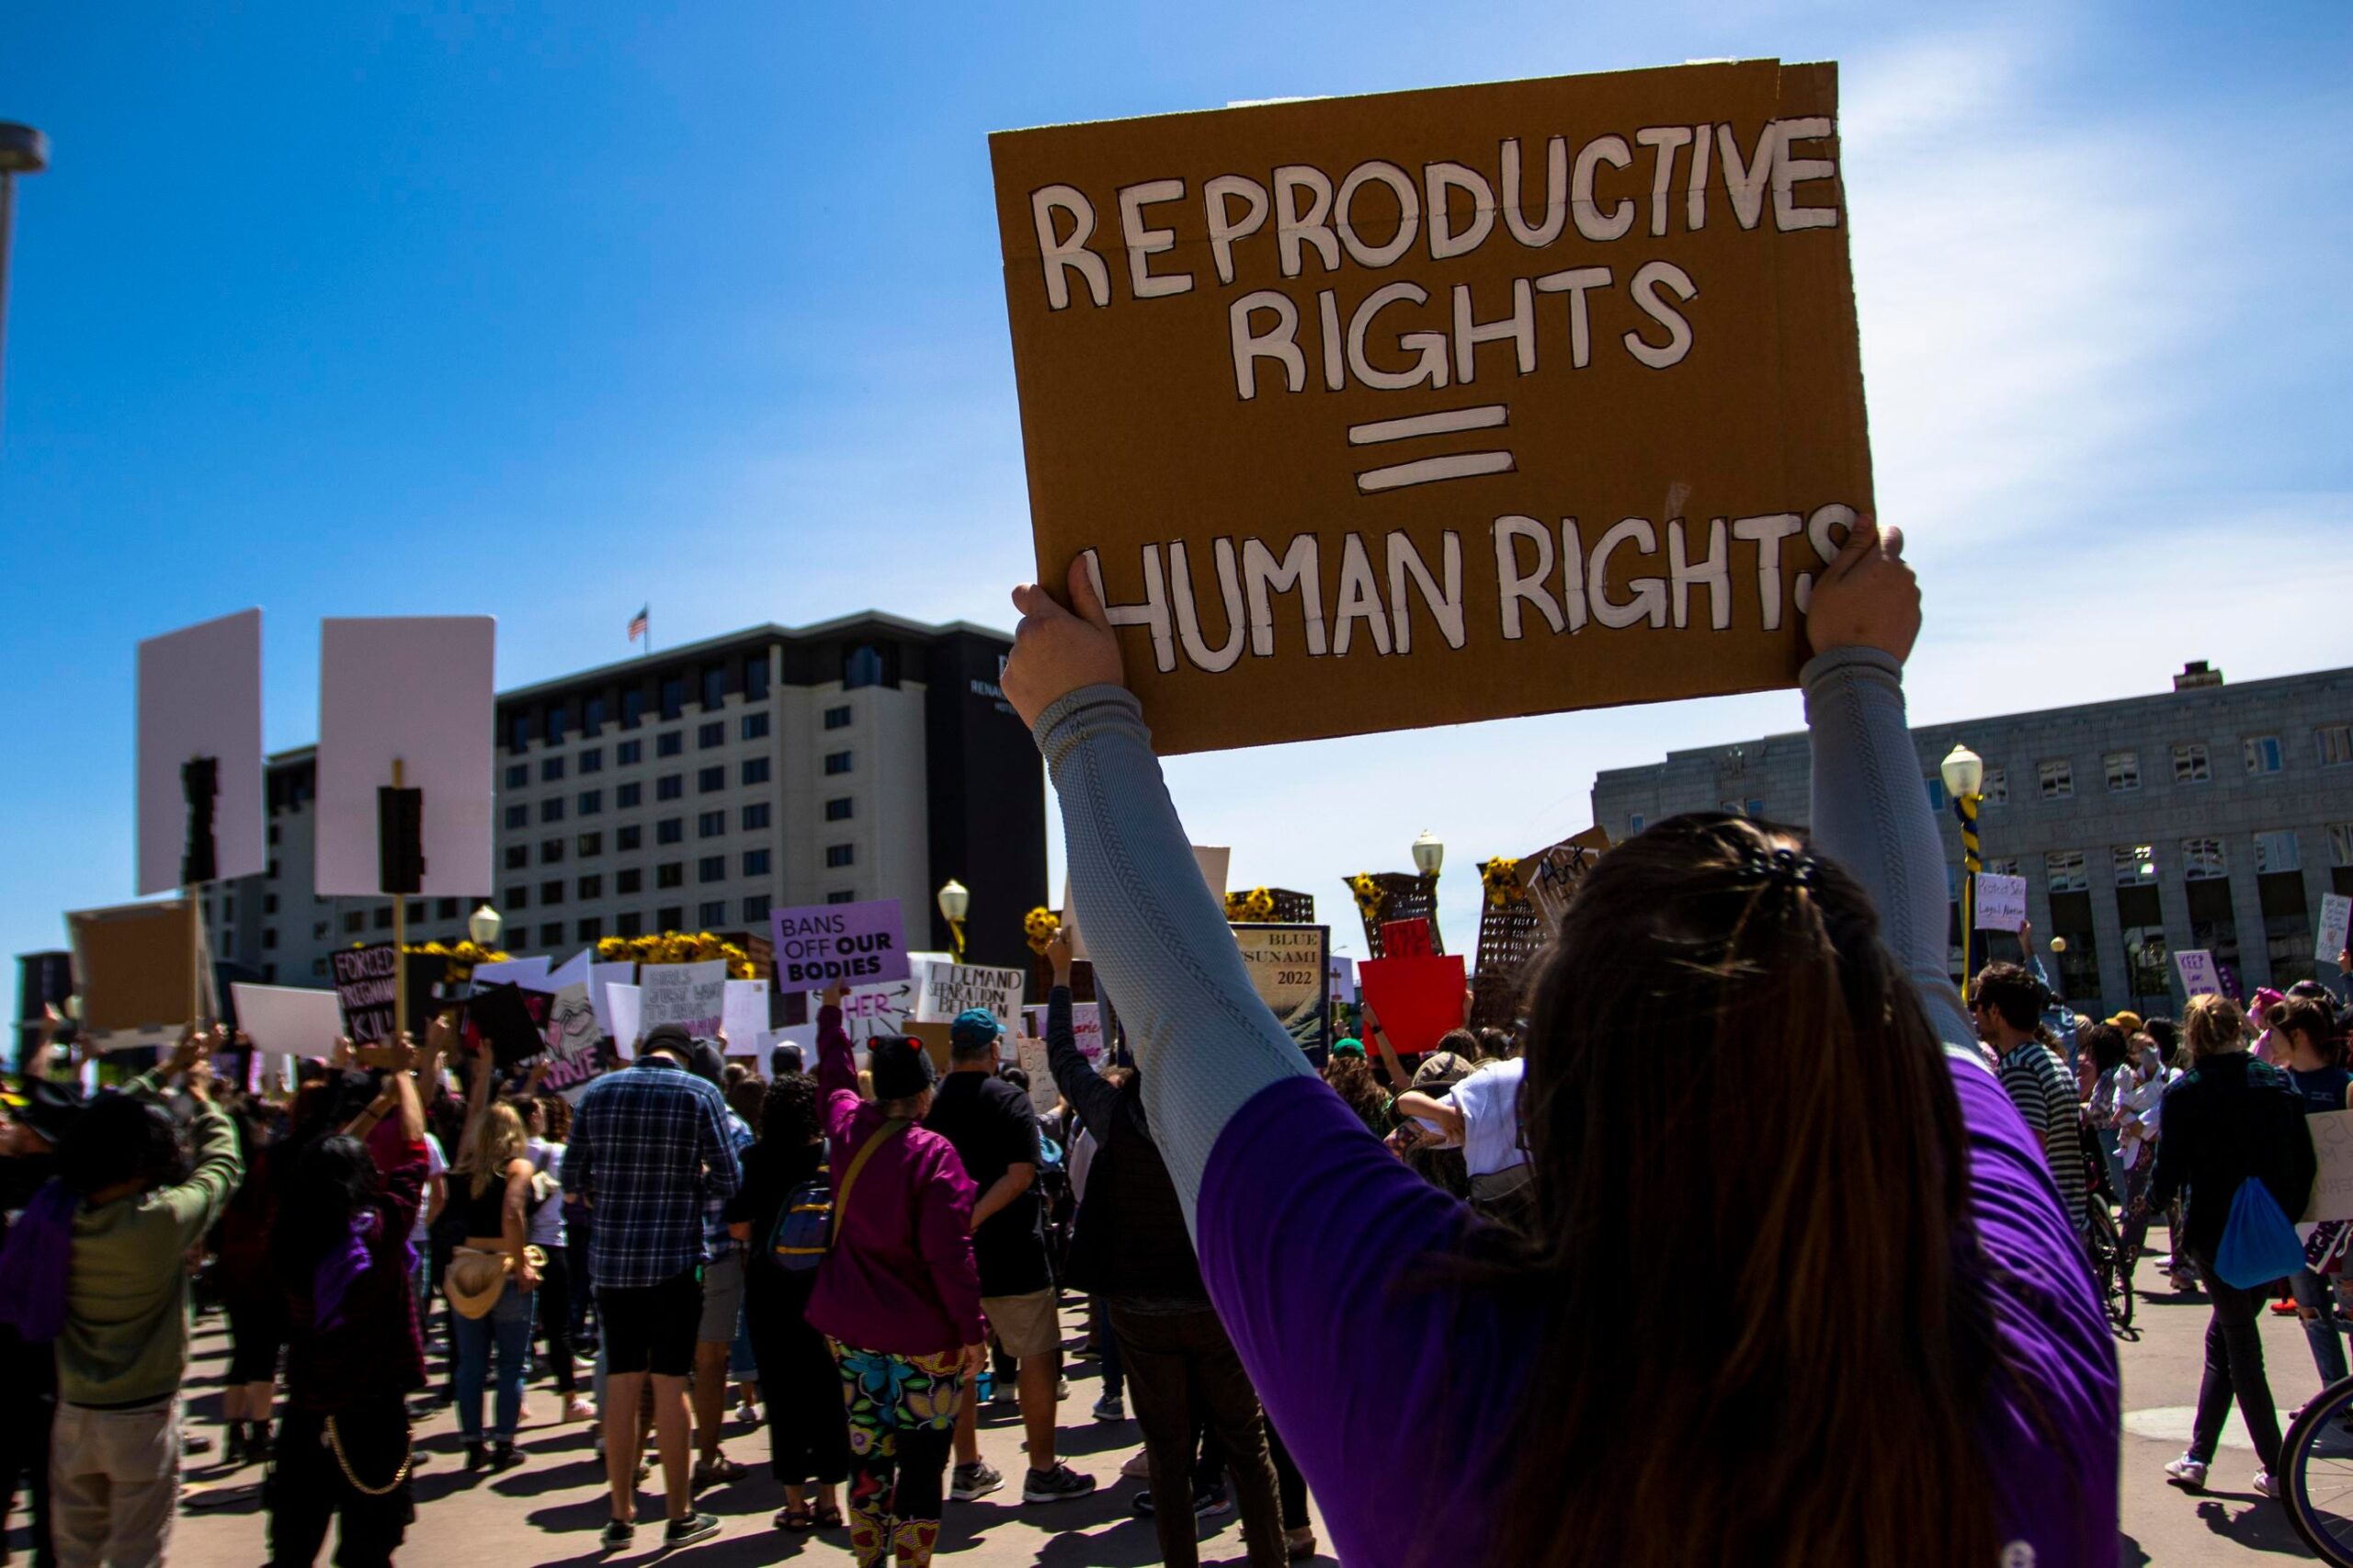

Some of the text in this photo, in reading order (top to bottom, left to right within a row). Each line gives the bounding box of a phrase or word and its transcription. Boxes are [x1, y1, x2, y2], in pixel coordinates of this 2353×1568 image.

[1031, 117, 1839, 312] REPRODUCTIVE
[1228, 260, 1699, 401] RIGHTS
[1082, 528, 1467, 674] HUMAN
[781, 915, 846, 937] BANS
[784, 932, 892, 960] OFF OUR
[1268, 934, 1318, 946] BLUE
[335, 946, 395, 983] FORCED
[787, 955, 881, 983] BODIES
[1242, 950, 1316, 964] SUNAMI
[950, 965, 1022, 990] DEMAND
[1278, 971, 1313, 984] 2022
[928, 981, 1006, 1003] SEPARATION
[843, 994, 892, 1019] HER
